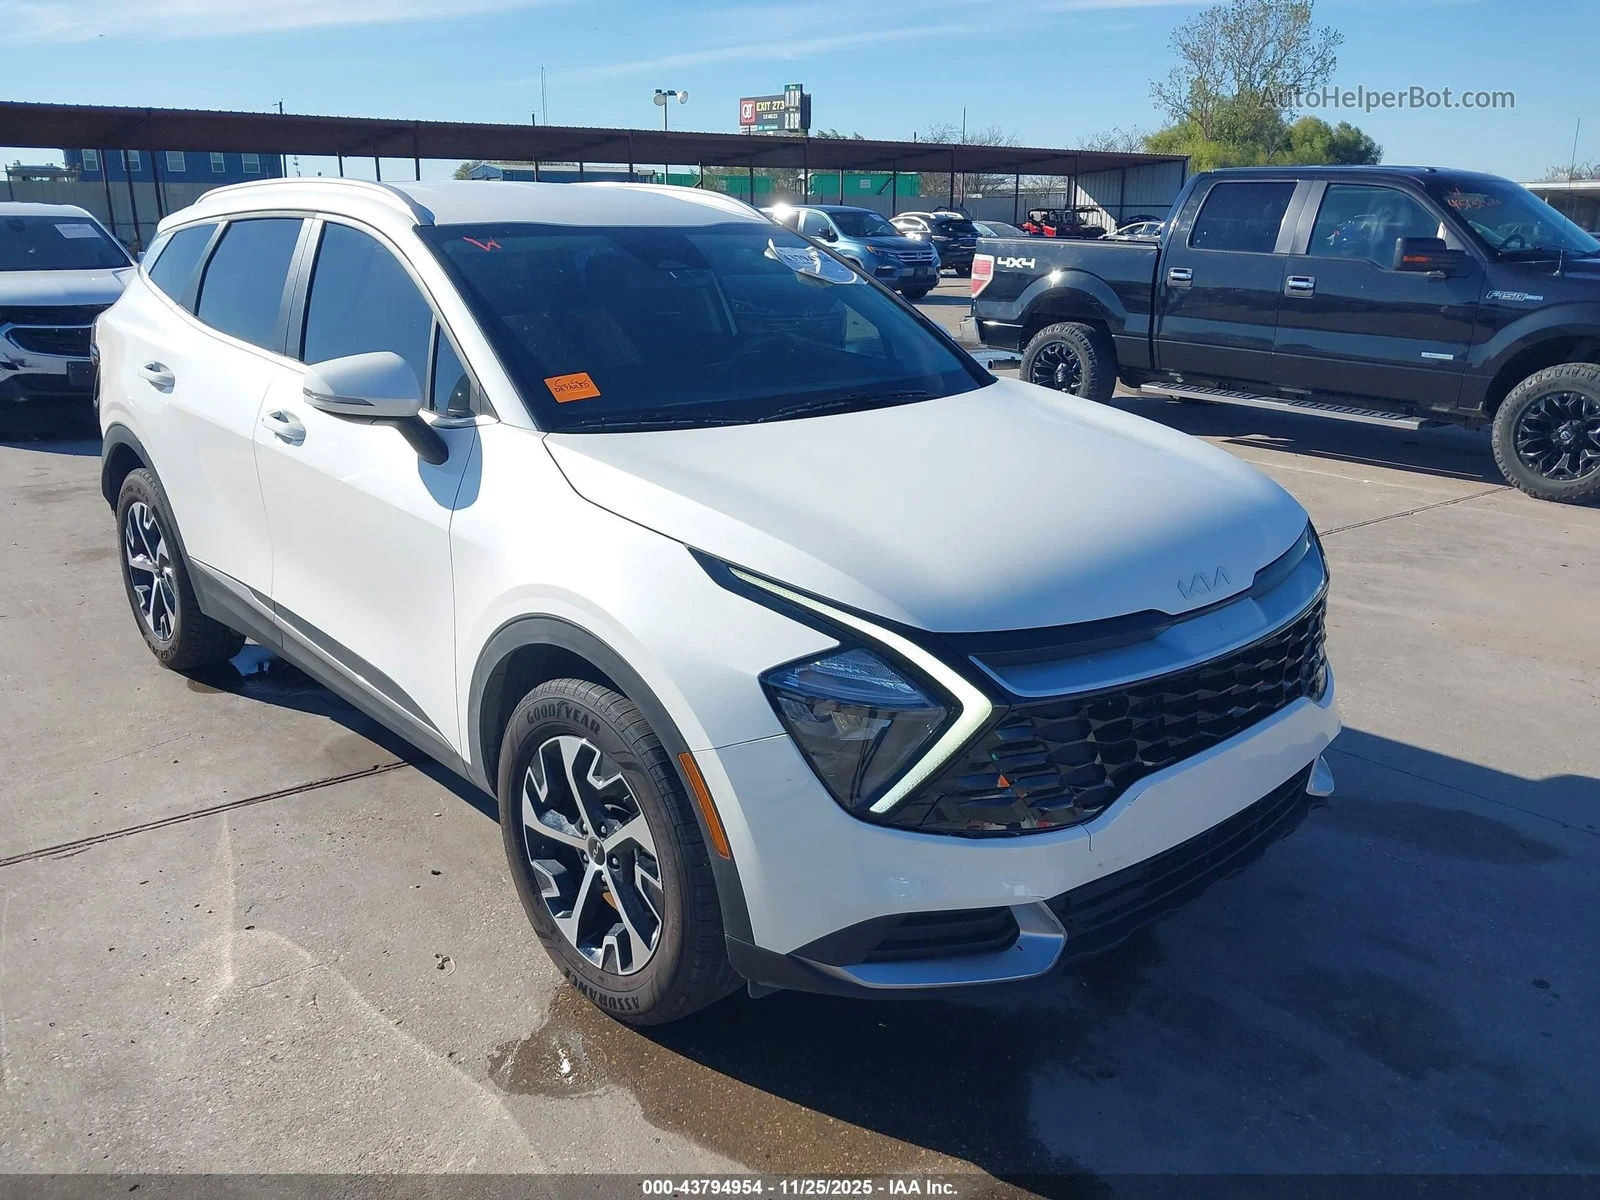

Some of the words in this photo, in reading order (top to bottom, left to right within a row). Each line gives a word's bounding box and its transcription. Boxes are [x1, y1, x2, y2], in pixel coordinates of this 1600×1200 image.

[742, 104, 754, 119] QT
[756, 102, 771, 112] EXIT
[772, 100, 785, 111] 273
[526, 700, 601, 735] GOODYEAR
[563, 966, 640, 1011] ASSURANCE
